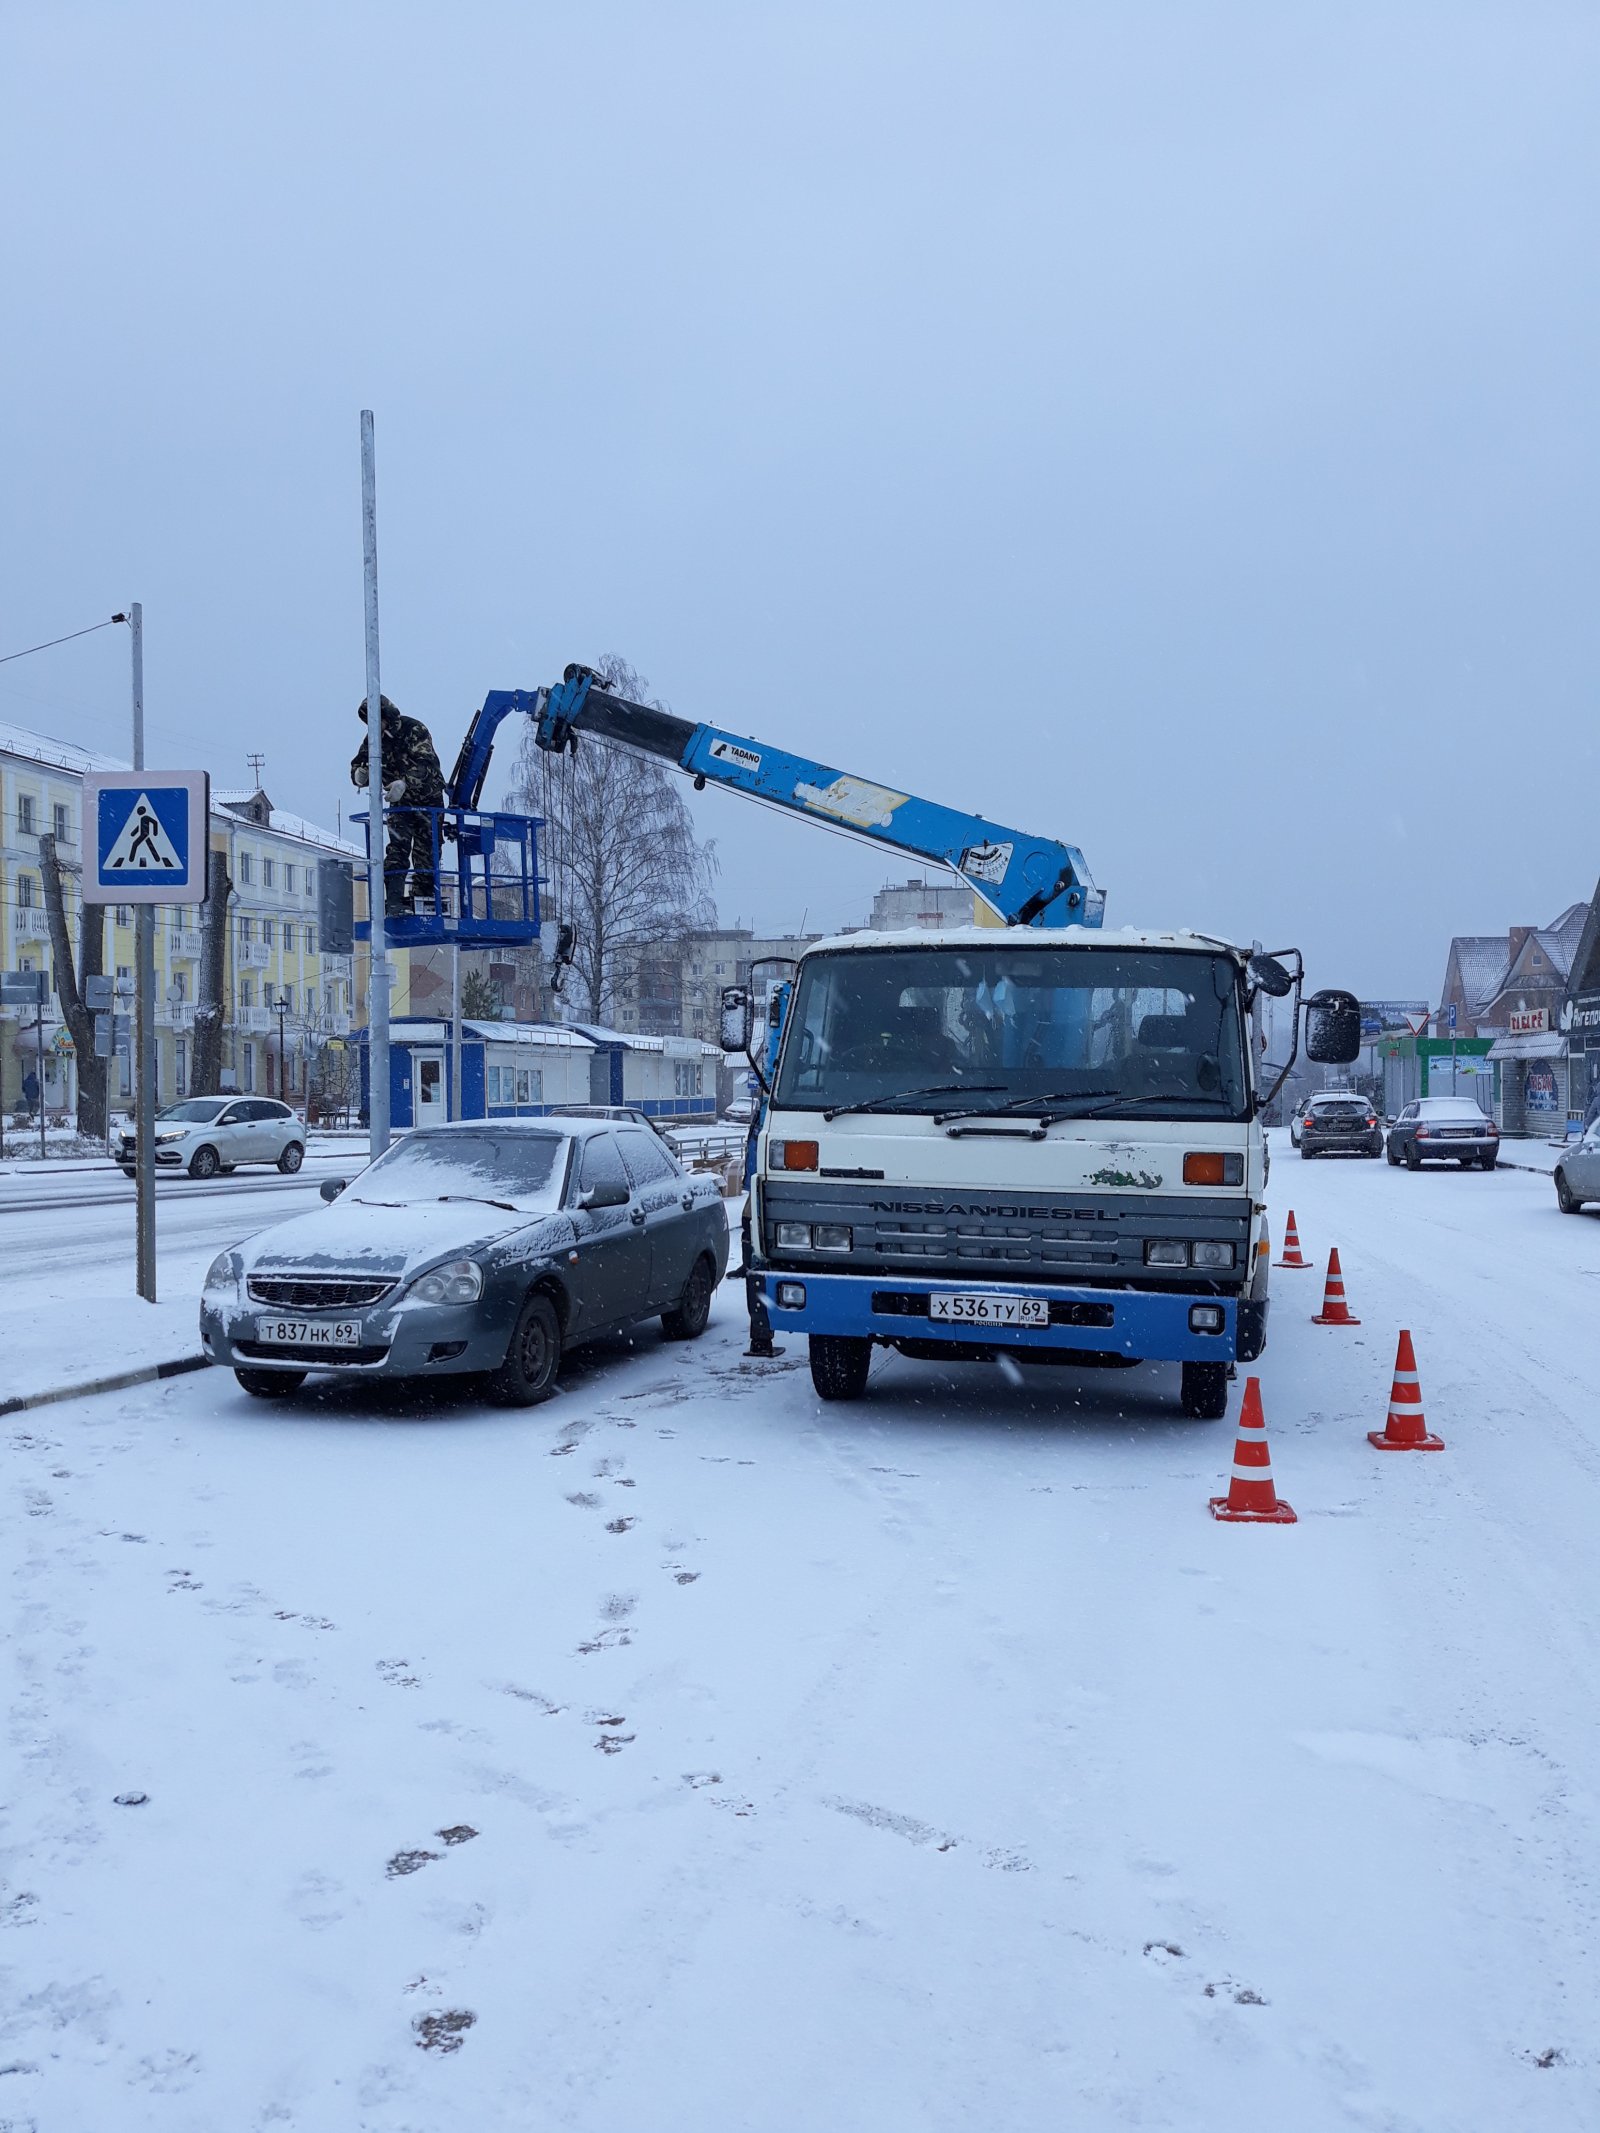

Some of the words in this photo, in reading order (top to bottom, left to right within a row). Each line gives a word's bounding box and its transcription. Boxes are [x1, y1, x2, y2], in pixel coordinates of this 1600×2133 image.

[731, 746, 760, 763] TADANO
[1021, 1302, 1041, 1317] 69
[335, 1325, 353, 1338] 69
